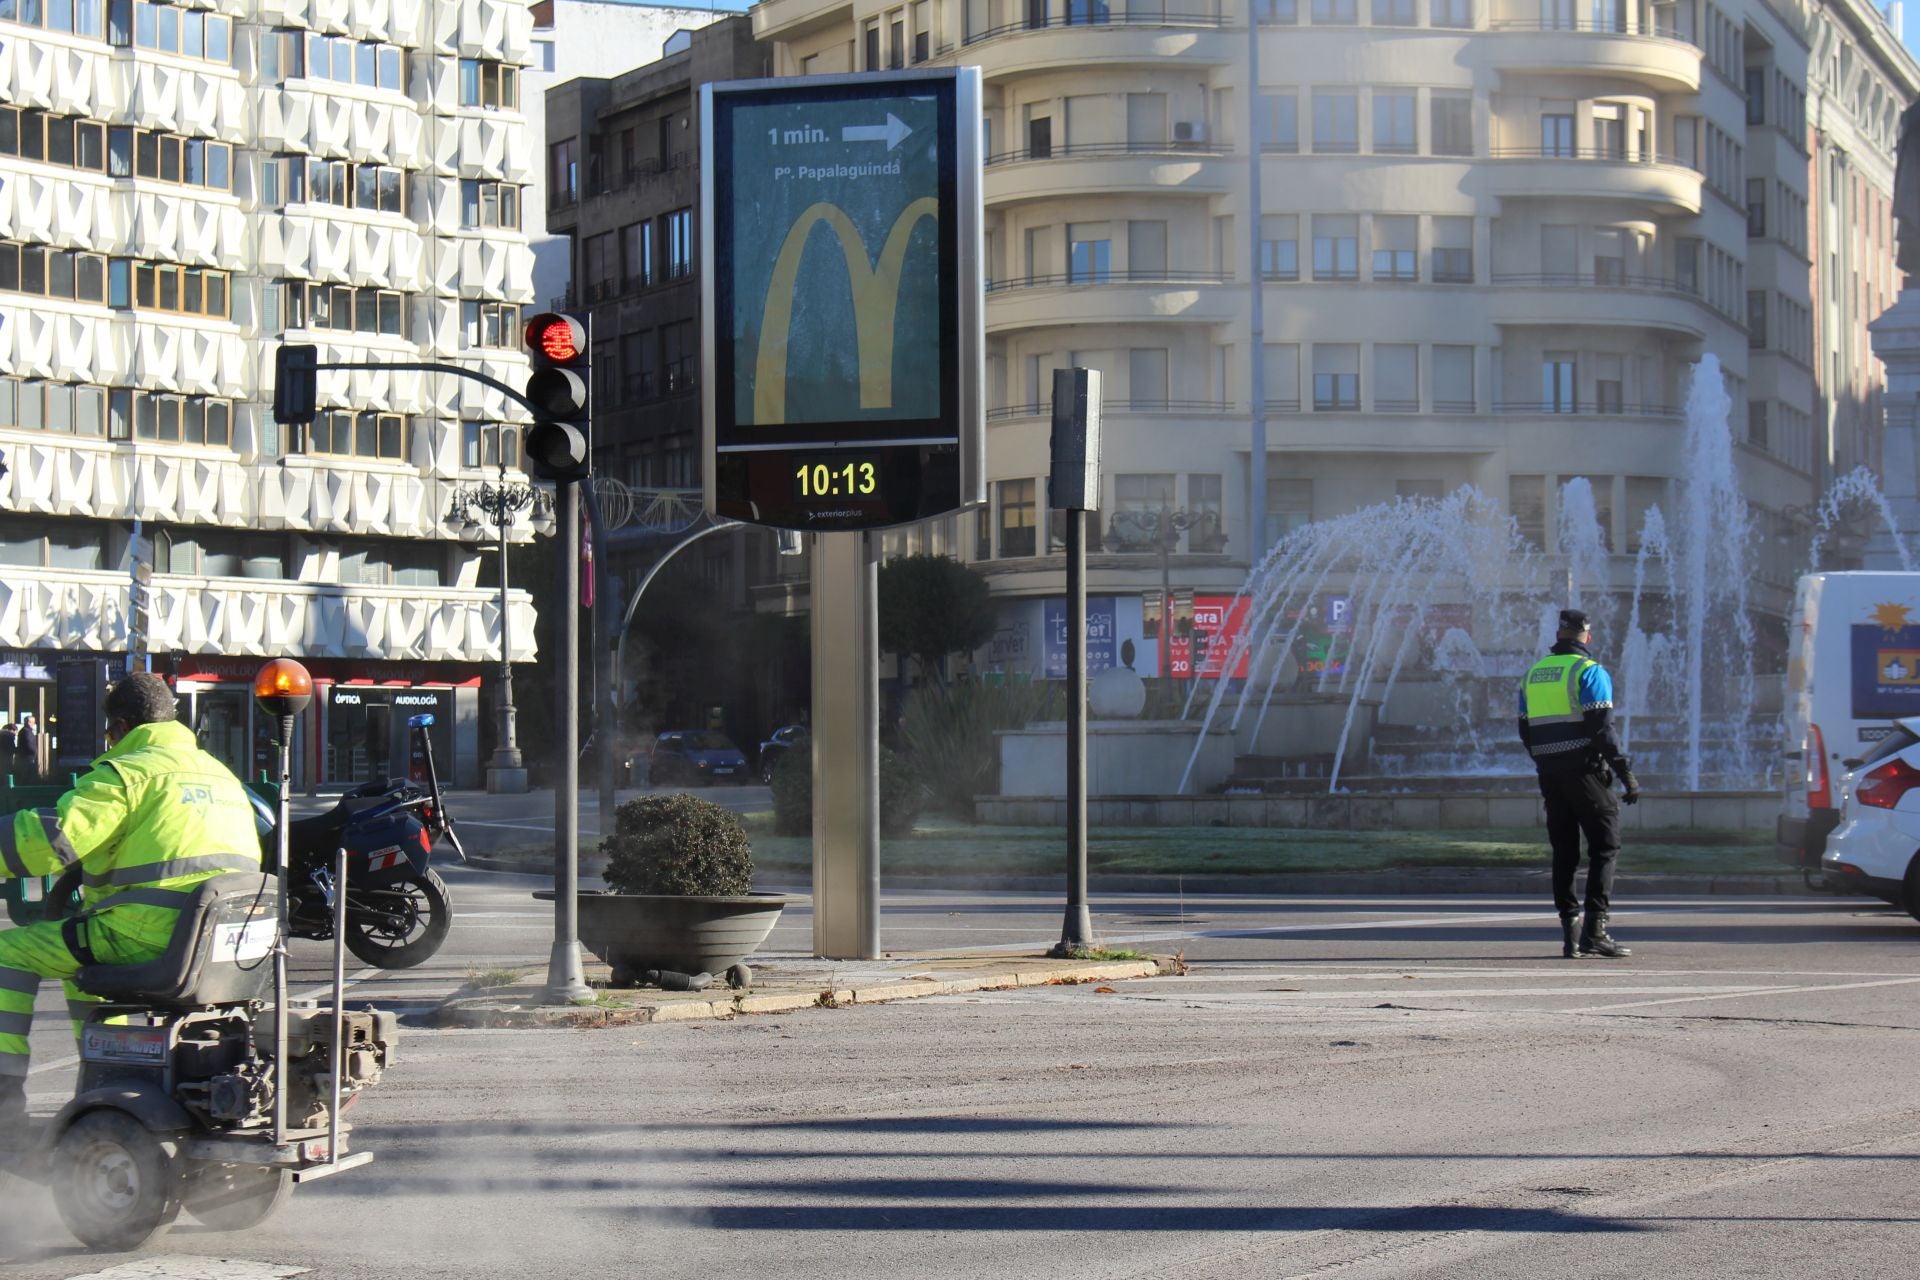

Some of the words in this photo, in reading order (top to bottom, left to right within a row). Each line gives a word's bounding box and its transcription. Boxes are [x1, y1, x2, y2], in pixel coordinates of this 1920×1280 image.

[768, 128, 777, 145] 1
[783, 124, 830, 144] min.
[798, 161, 900, 181] Papalaguinda
[796, 463, 876, 496] 10:13
[816, 509, 863, 518] exteriorplus
[1333, 600, 1346, 620] P
[1172, 660, 1188, 672] 20
[335, 692, 361, 705] ÓPTICA
[395, 693, 438, 705] AUDIOLOGÍA
[181, 788, 214, 804] API
